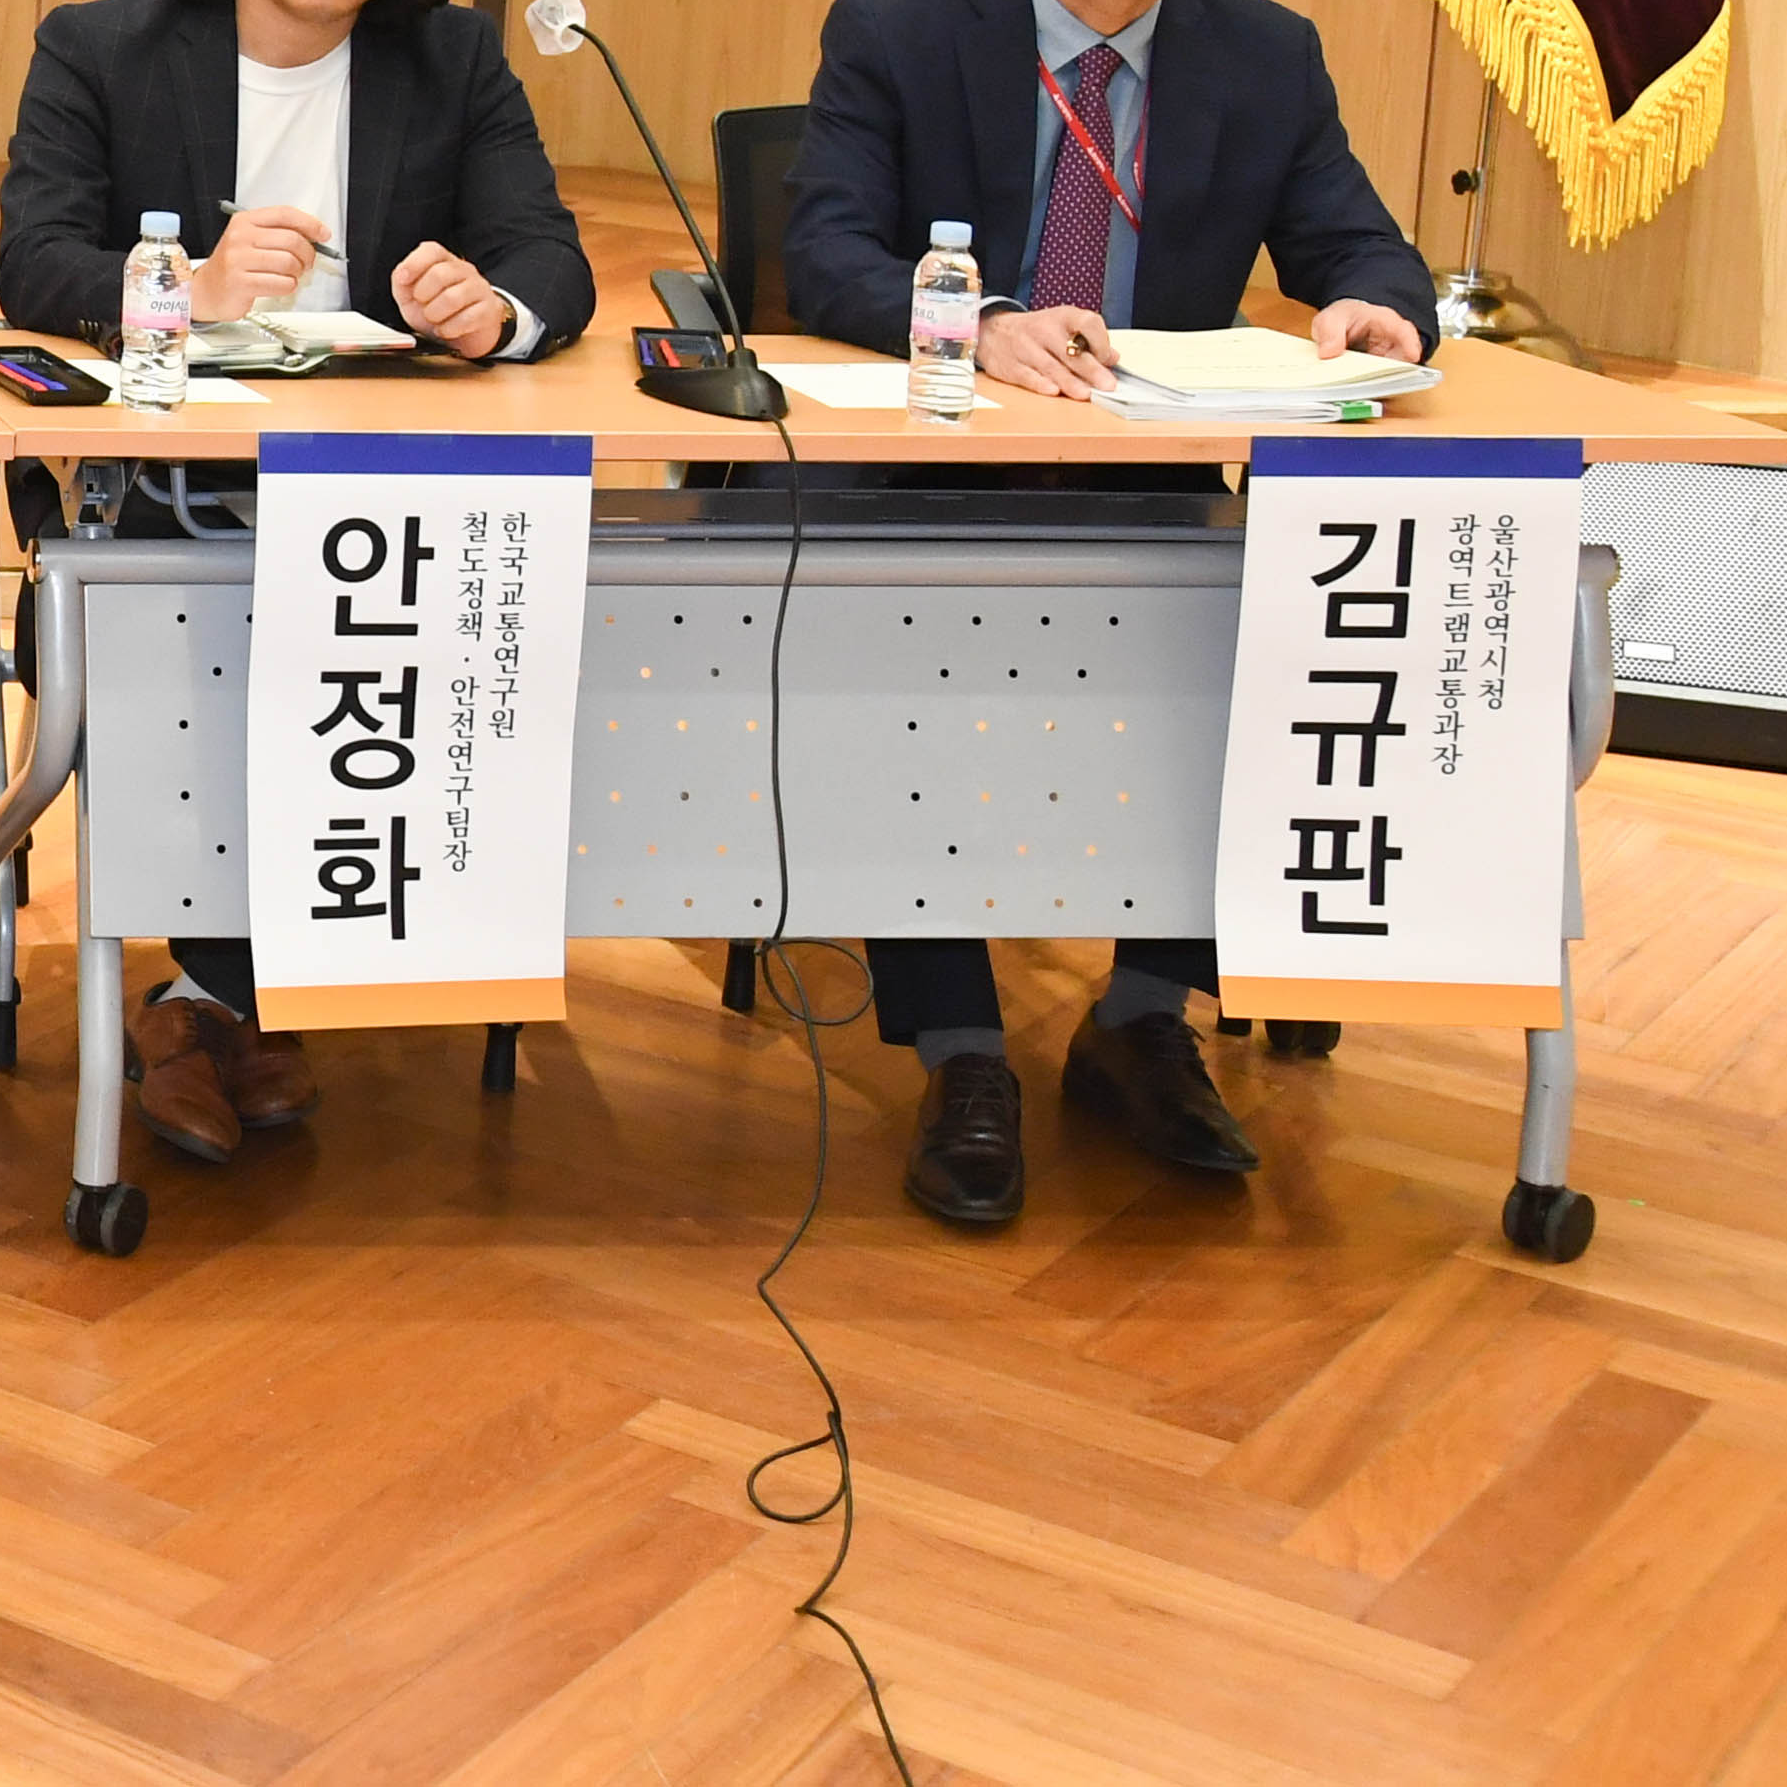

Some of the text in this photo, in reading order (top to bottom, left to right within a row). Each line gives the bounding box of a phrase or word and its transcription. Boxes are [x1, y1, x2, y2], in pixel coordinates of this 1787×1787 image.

[310, 516, 435, 940] 안정화
[487, 512, 531, 738] 한국교통연구원
[1284, 519, 1416, 936] 김규판
[1432, 514, 1480, 775] 광역트램교통과장
[1476, 515, 1520, 710] 울산광역시청
